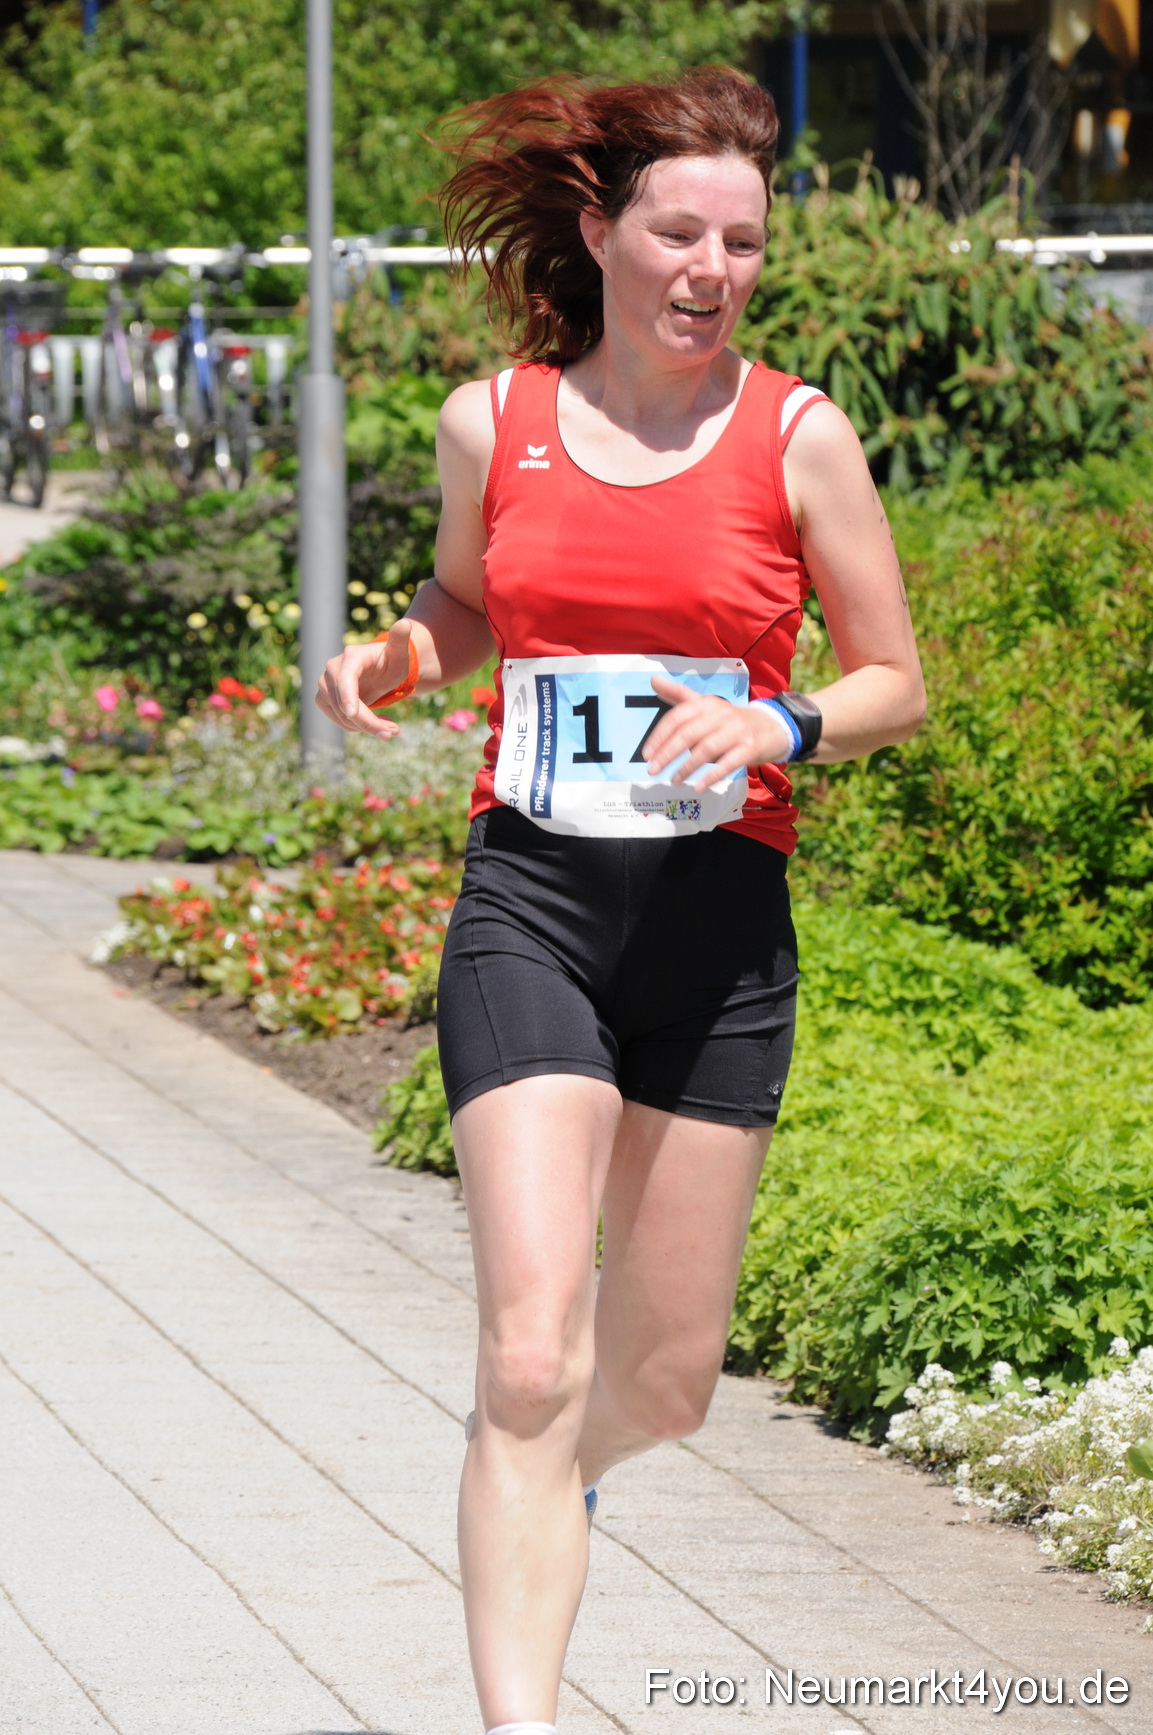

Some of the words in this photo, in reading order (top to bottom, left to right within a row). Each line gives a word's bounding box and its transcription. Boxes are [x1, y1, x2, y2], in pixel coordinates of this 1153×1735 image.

[541, 681, 554, 726] systems
[541, 728, 552, 756] track
[572, 694, 732, 765] 17
[534, 757, 551, 812] Pfleiderer
